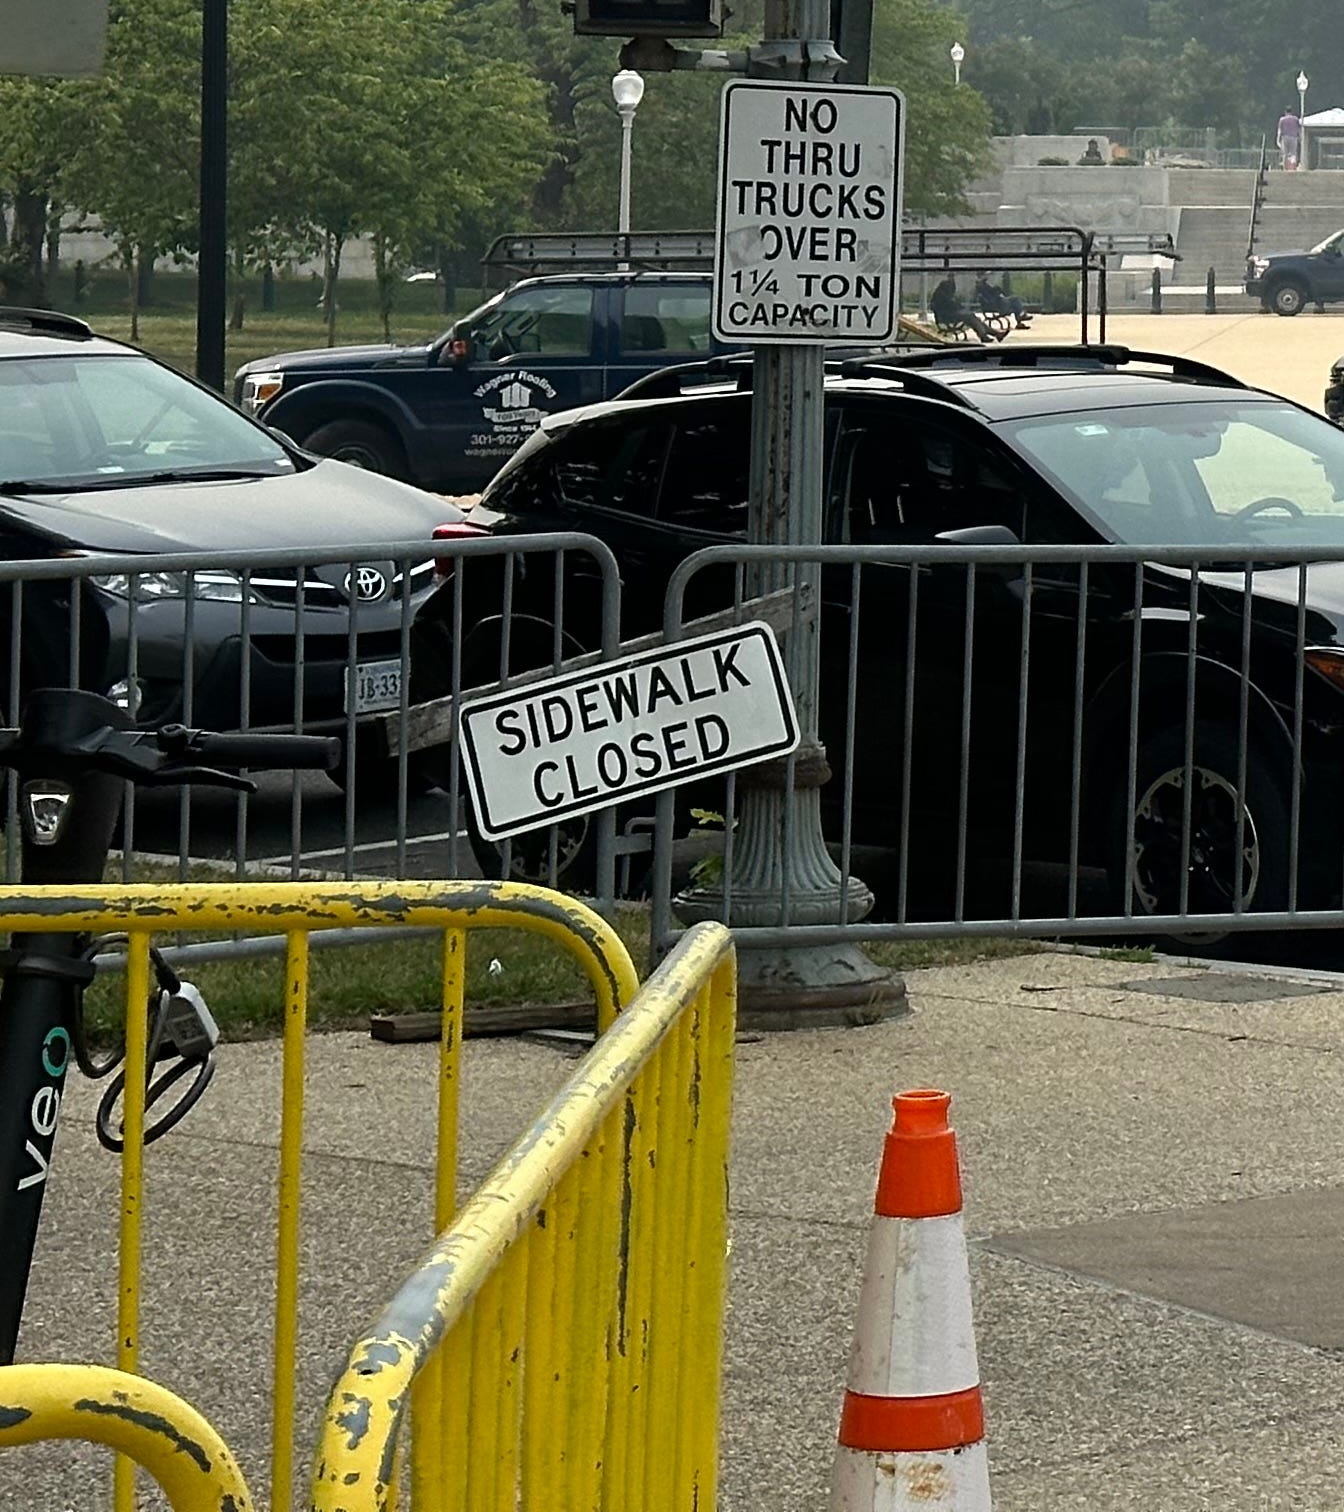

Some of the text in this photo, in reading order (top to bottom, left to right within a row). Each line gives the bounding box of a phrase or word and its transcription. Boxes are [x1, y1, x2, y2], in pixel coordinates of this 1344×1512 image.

[784, 98, 838, 134] NO
[760, 139, 861, 178] THRU
[731, 180, 886, 220] TRUCKS
[760, 224, 857, 263] OVER
[797, 274, 881, 299] TON
[728, 301, 879, 329] CAPACITY
[495, 643, 751, 756] SIDEWALK
[533, 714, 730, 808] CLOSED
[17, 1026, 71, 1191] veo
